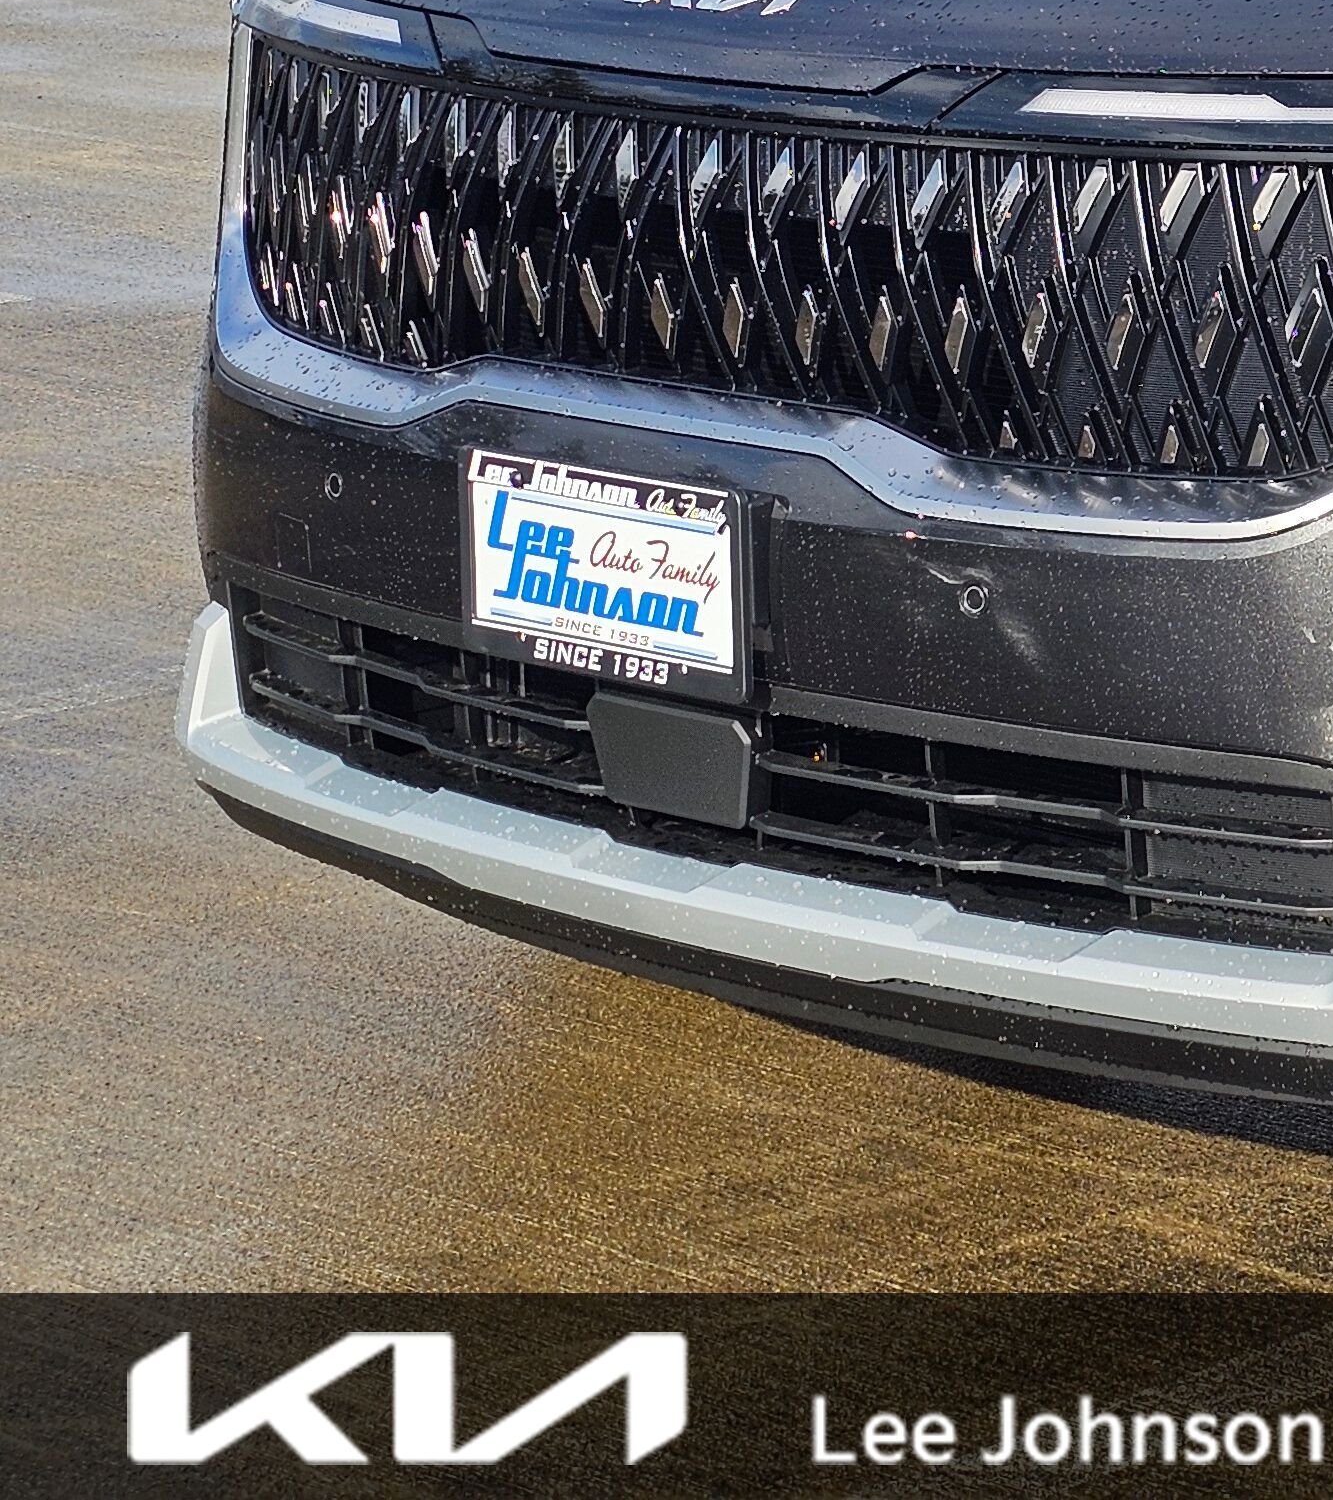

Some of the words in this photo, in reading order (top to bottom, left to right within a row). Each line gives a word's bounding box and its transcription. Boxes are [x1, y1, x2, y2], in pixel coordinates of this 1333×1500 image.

[522, 460, 641, 509] Johnson
[487, 490, 579, 563] Lee
[493, 550, 704, 637] Johnson
[590, 531, 643, 574] Auto
[646, 540, 720, 604] Family
[533, 638, 604, 672] SINCE
[613, 653, 669, 685] 1933
[554, 616, 602, 637] SINCE
[610, 628, 650, 647] 1933
